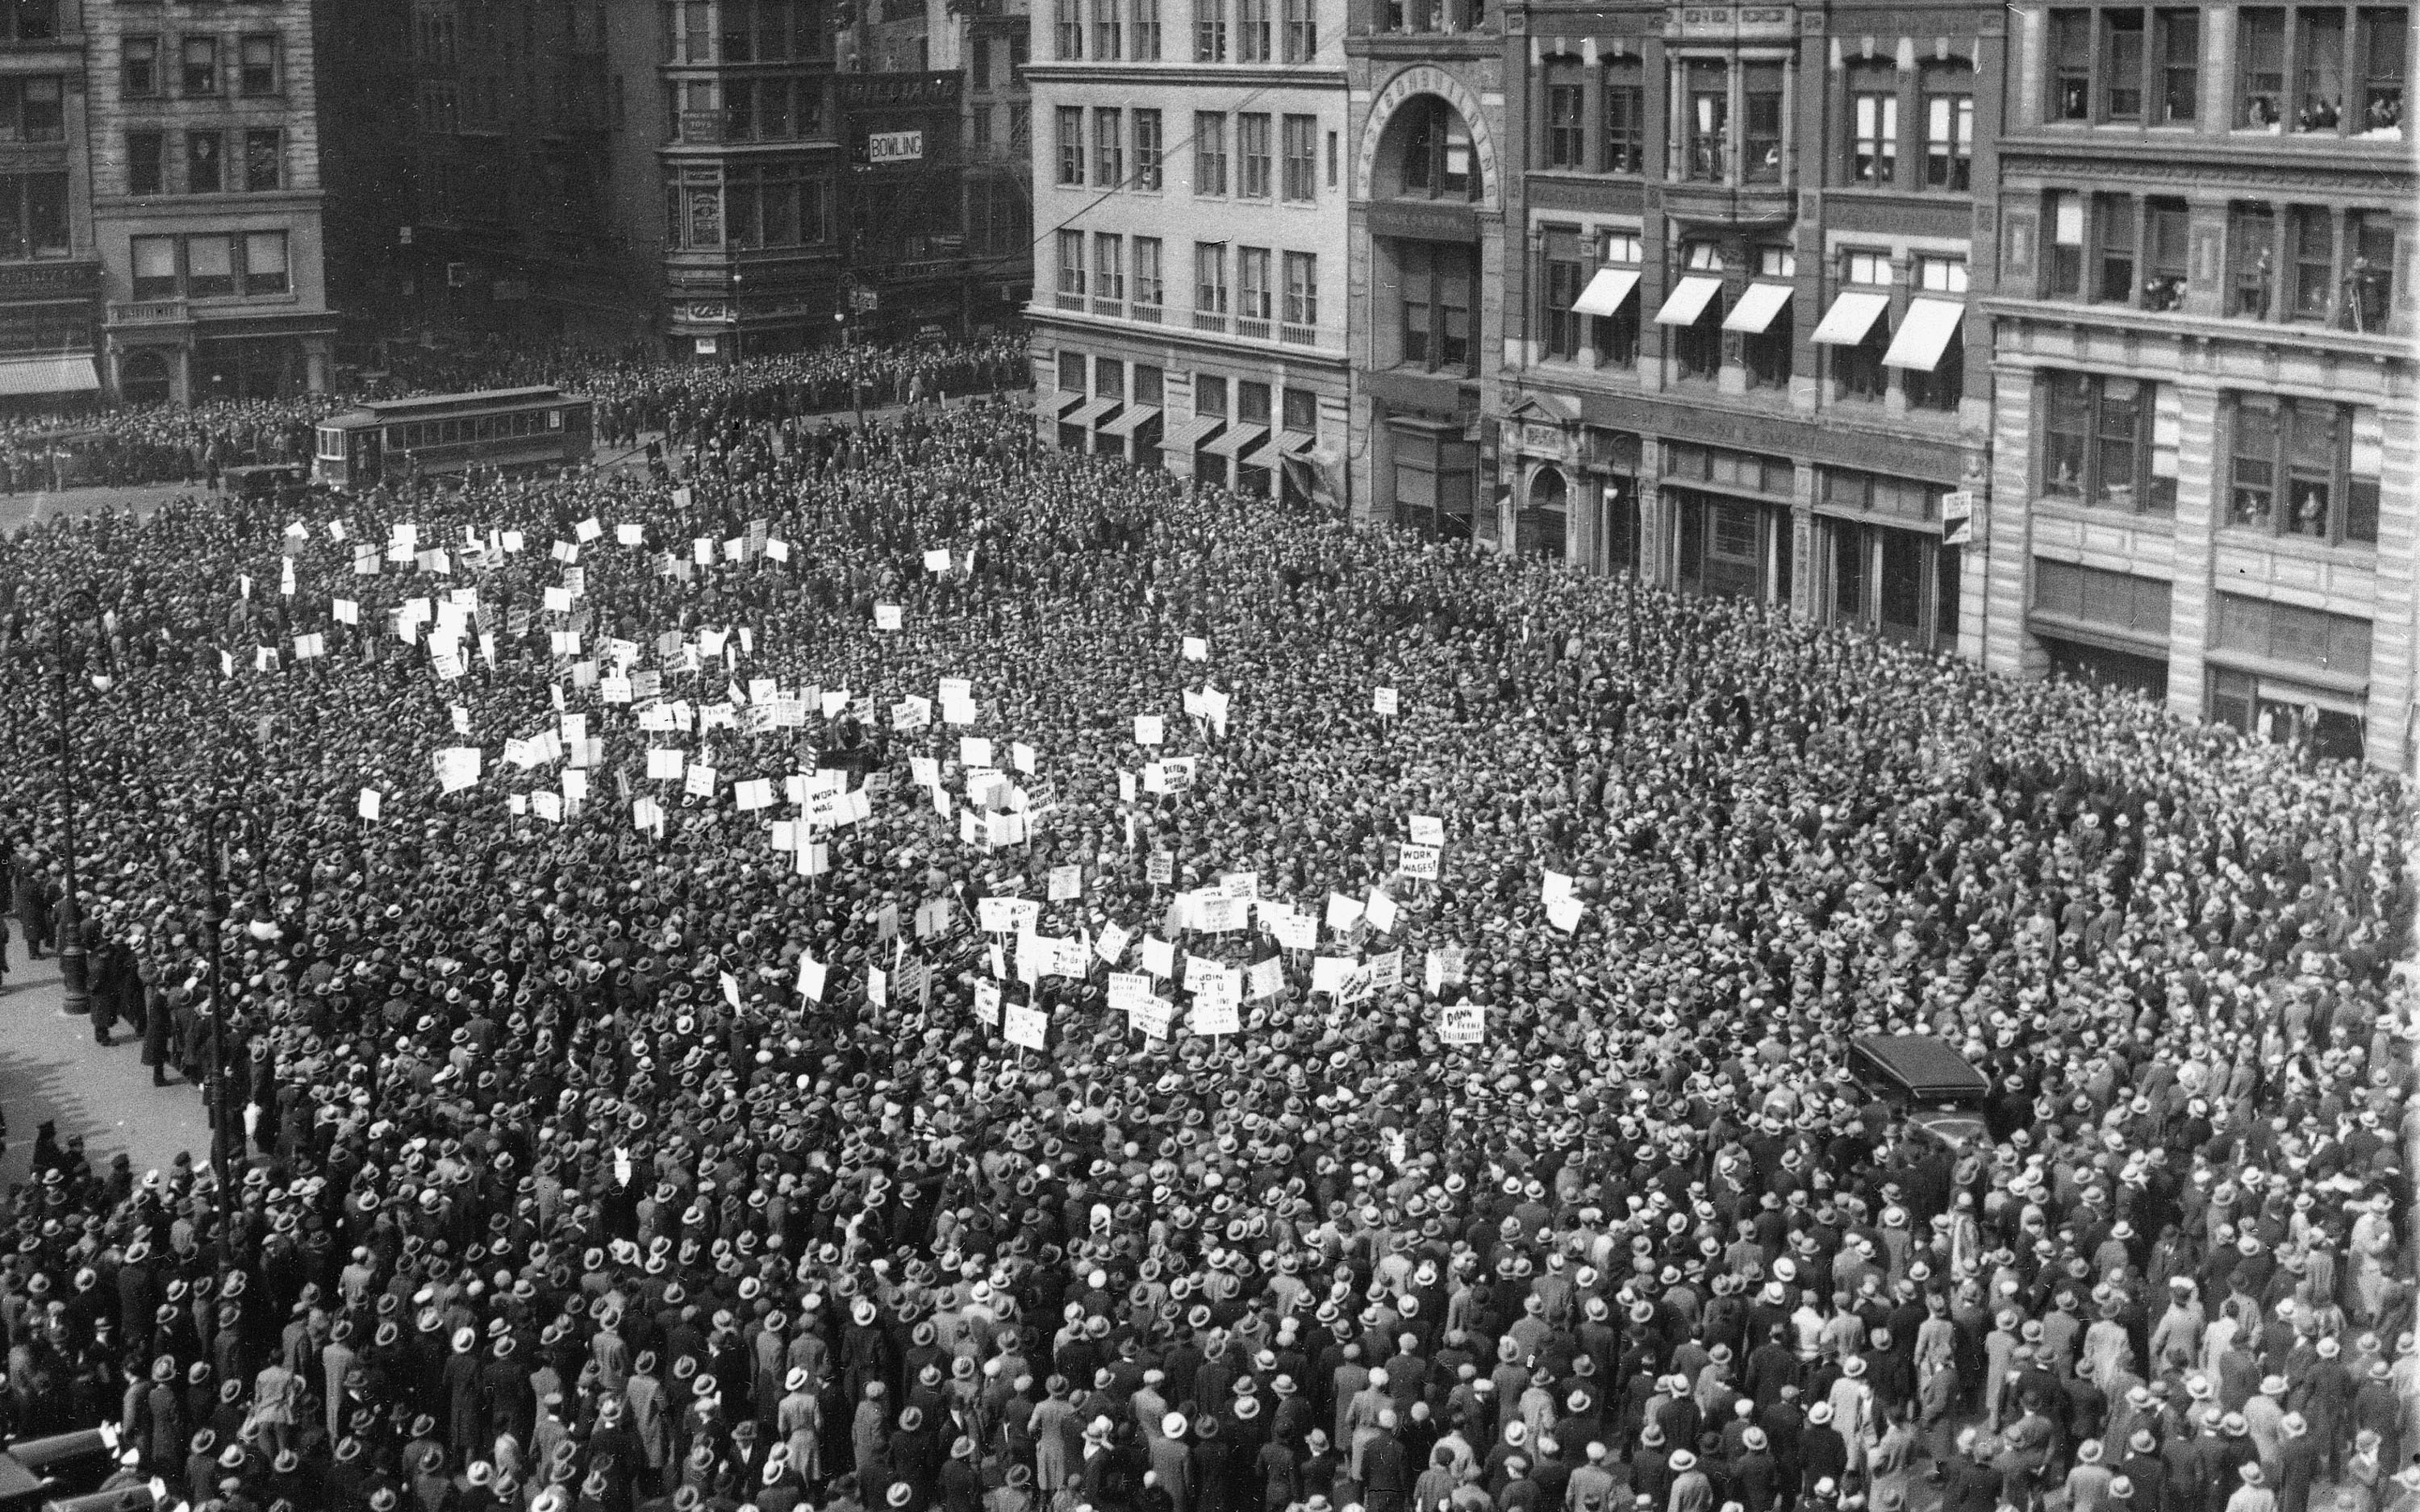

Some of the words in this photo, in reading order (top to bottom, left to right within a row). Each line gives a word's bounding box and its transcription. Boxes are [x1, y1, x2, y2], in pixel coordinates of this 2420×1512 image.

[872, 135, 921, 157] BOWLING
[812, 787, 839, 802] WORK
[1027, 785, 1050, 801] WORK
[1403, 850, 1433, 860] WORK
[1401, 860, 1437, 873] WAGES!
[1053, 950, 1061, 961] 7
[1199, 973, 1224, 981] JOIN
